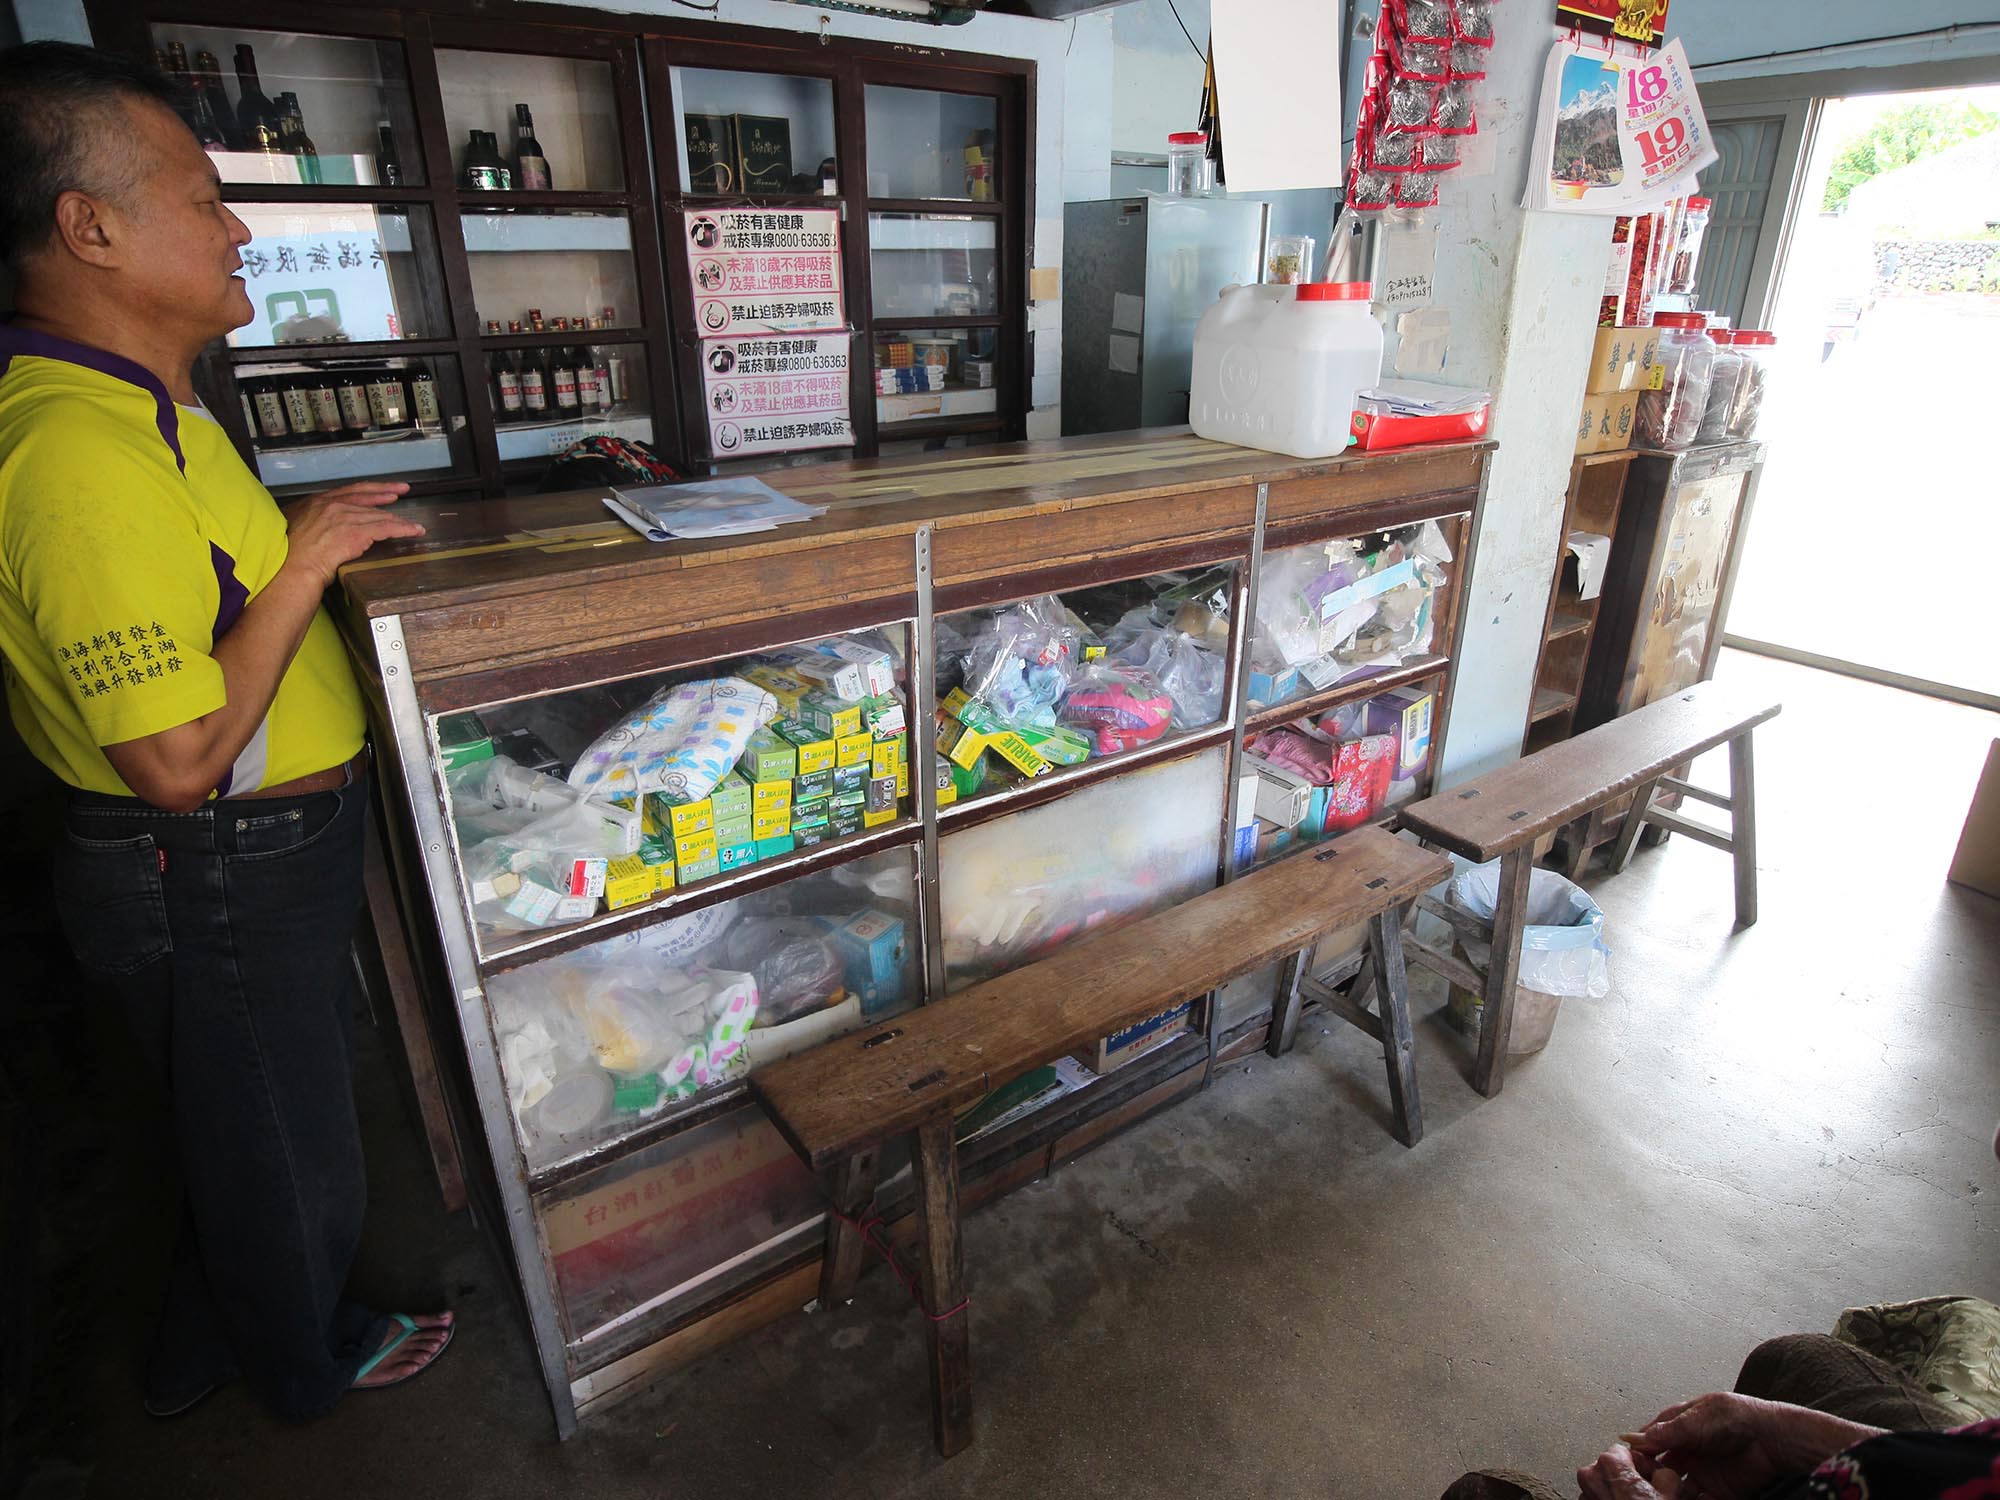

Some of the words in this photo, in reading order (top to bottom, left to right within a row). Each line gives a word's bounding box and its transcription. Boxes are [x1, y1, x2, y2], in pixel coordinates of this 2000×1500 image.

[1627, 66, 1668, 108] 18
[1629, 92, 1672, 118] 星期六
[1634, 117, 1684, 167] 19
[1645, 143, 1689, 176] 星期日
[721, 214, 804, 231] 吸菸有害健康
[727, 256, 832, 273] 未滿18歲不得吸菸
[729, 274, 833, 291] 及禁止供應其菸品
[732, 302, 835, 320] 禁止迫誘孕婦吸菸
[738, 340, 817, 356] 吸菸有害健康
[738, 355, 847, 373] 戒菸專線0800-636363
[740, 376, 842, 396] 未滿18歲不得吸菸
[741, 394, 842, 413] 及禁止供應其菸品
[744, 422, 844, 442] 禁止迫誘孕婦吸菸
[1002, 736, 1041, 769] DARLIE
